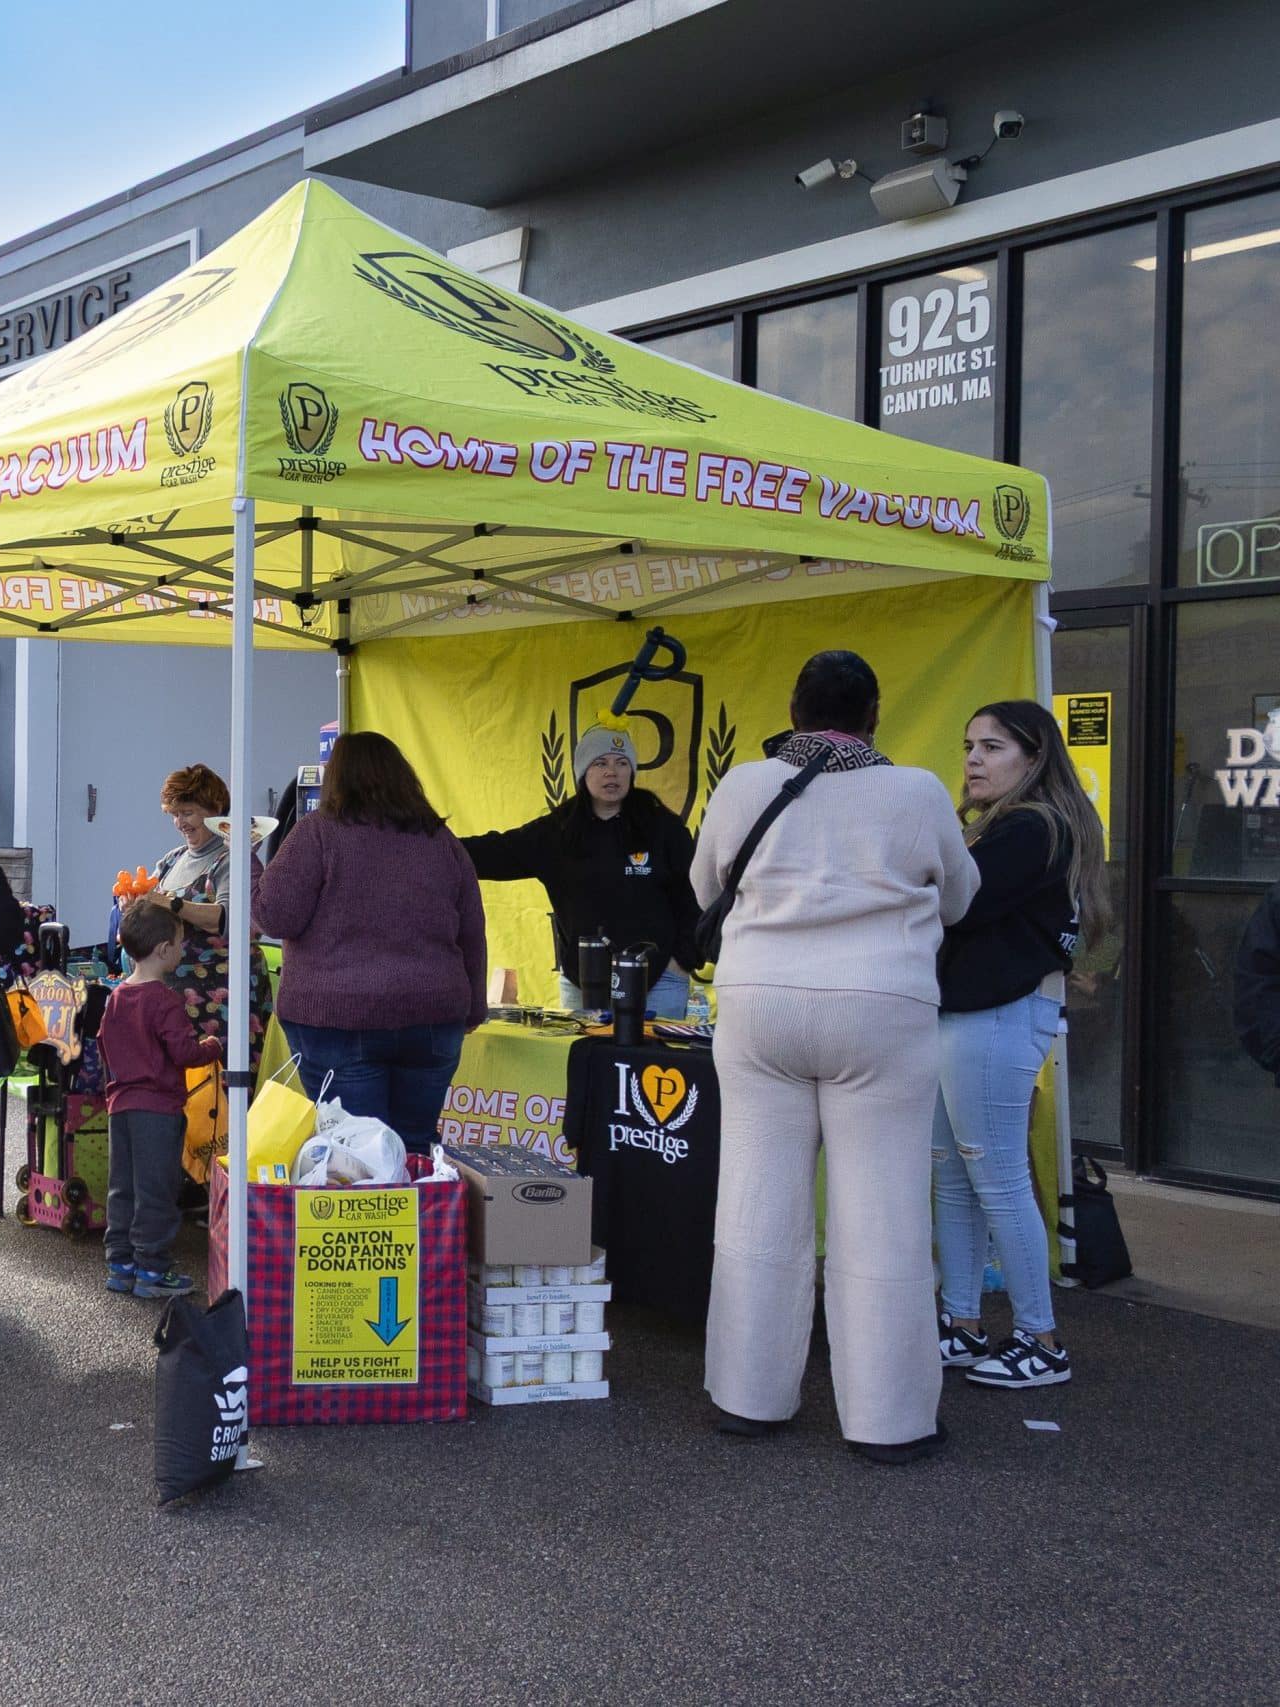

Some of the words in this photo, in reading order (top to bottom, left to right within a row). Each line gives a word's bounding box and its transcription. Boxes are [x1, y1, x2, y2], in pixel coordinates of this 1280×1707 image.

[888, 279, 991, 357] 925
[879, 350, 967, 388] TURNPIKE
[970, 345, 997, 371] ST.
[480, 362, 718, 424] prestige
[882, 382, 959, 416] CANTON,
[961, 375, 992, 402] MA
[160, 454, 217, 488] prestige
[277, 456, 348, 483] prestige
[284, 471, 302, 483] CAR
[302, 473, 324, 485] WASH
[358, 417, 519, 478] HOME
[529, 440, 597, 485] OF
[604, 441, 689, 498] THE
[695, 452, 812, 515] FREE
[816, 473, 986, 540] VACUUM
[613, 1062, 631, 1116] I
[524, 1094, 568, 1125] OF
[608, 1123, 689, 1164] prestige
[337, 1193, 409, 1219] prestige
[524, 1186, 562, 1199] Barilla
[345, 1212, 362, 1221] CAR
[365, 1211, 387, 1220] WASH
[299, 1245, 347, 1258] FOOD
[350, 1243, 415, 1258] PANTRY
[322, 1230, 393, 1245] CANTON
[307, 1257, 407, 1272] DONATIONS
[296, 1369, 346, 1379] HUNGER
[348, 1368, 413, 1378] TOGETHER!
[310, 1357, 341, 1367] HELP
[343, 1357, 360, 1367] US
[363, 1356, 401, 1367] FIGHT
